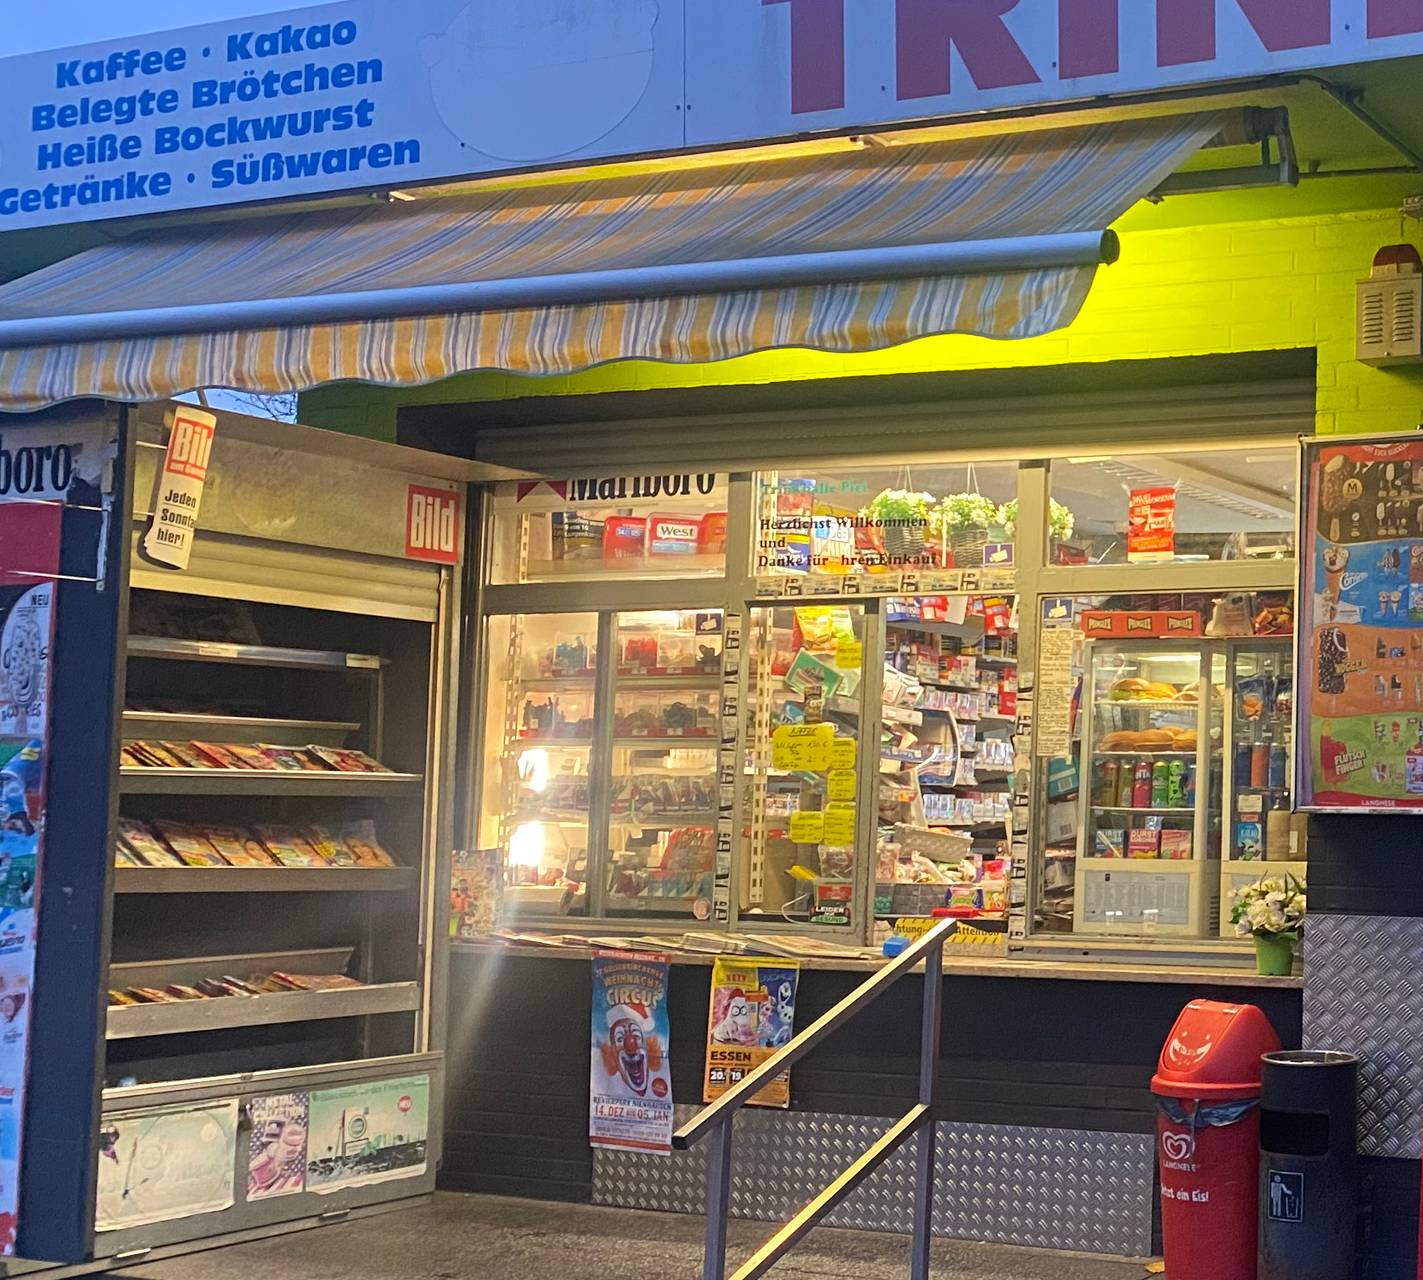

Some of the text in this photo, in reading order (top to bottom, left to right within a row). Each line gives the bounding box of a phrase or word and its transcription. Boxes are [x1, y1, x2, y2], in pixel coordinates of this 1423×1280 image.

[57, 20, 357, 89] Kaffee Kakao
[31, 58, 383, 131] Belegte Brötchen
[37, 99, 375, 170] Heiße Bockwurst
[0, 138, 420, 215] Getränke Süßwaren
[164, 488, 198, 509] Jeden
[409, 494, 456, 552] Bild
[660, 525, 696, 537] West
[760, 515, 928, 530] Herzlichst Willkommen
[156, 527, 186, 547] hier!
[760, 537, 786, 548] und
[758, 555, 802, 567] Danke
[806, 554, 829, 566] für
[879, 552, 937, 566] Einkauf
[710, 1050, 752, 1062] ESSEN
[710, 1071, 726, 1081] 20.
[608, 1105, 625, 1118] DEZ
[653, 1110, 669, 1122] JAN
